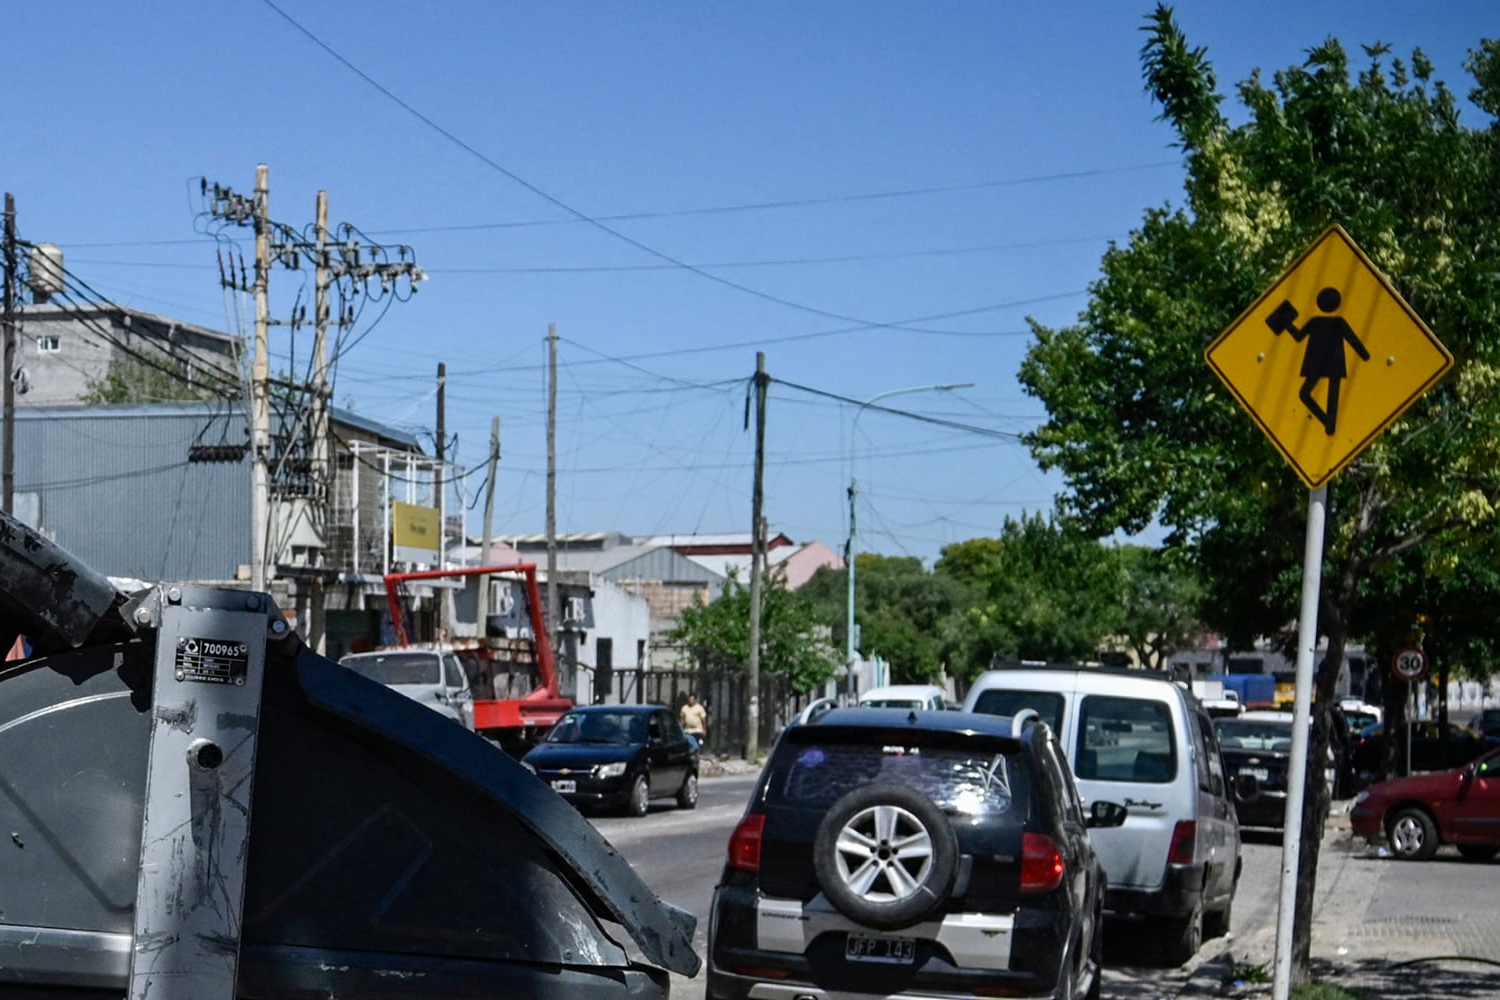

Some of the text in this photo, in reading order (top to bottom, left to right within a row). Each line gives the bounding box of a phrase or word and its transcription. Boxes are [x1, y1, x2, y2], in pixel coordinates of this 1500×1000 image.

[203, 642, 240, 657] 700965
[1400, 655, 1421, 670] 30
[851, 939, 912, 958] JFP 143
